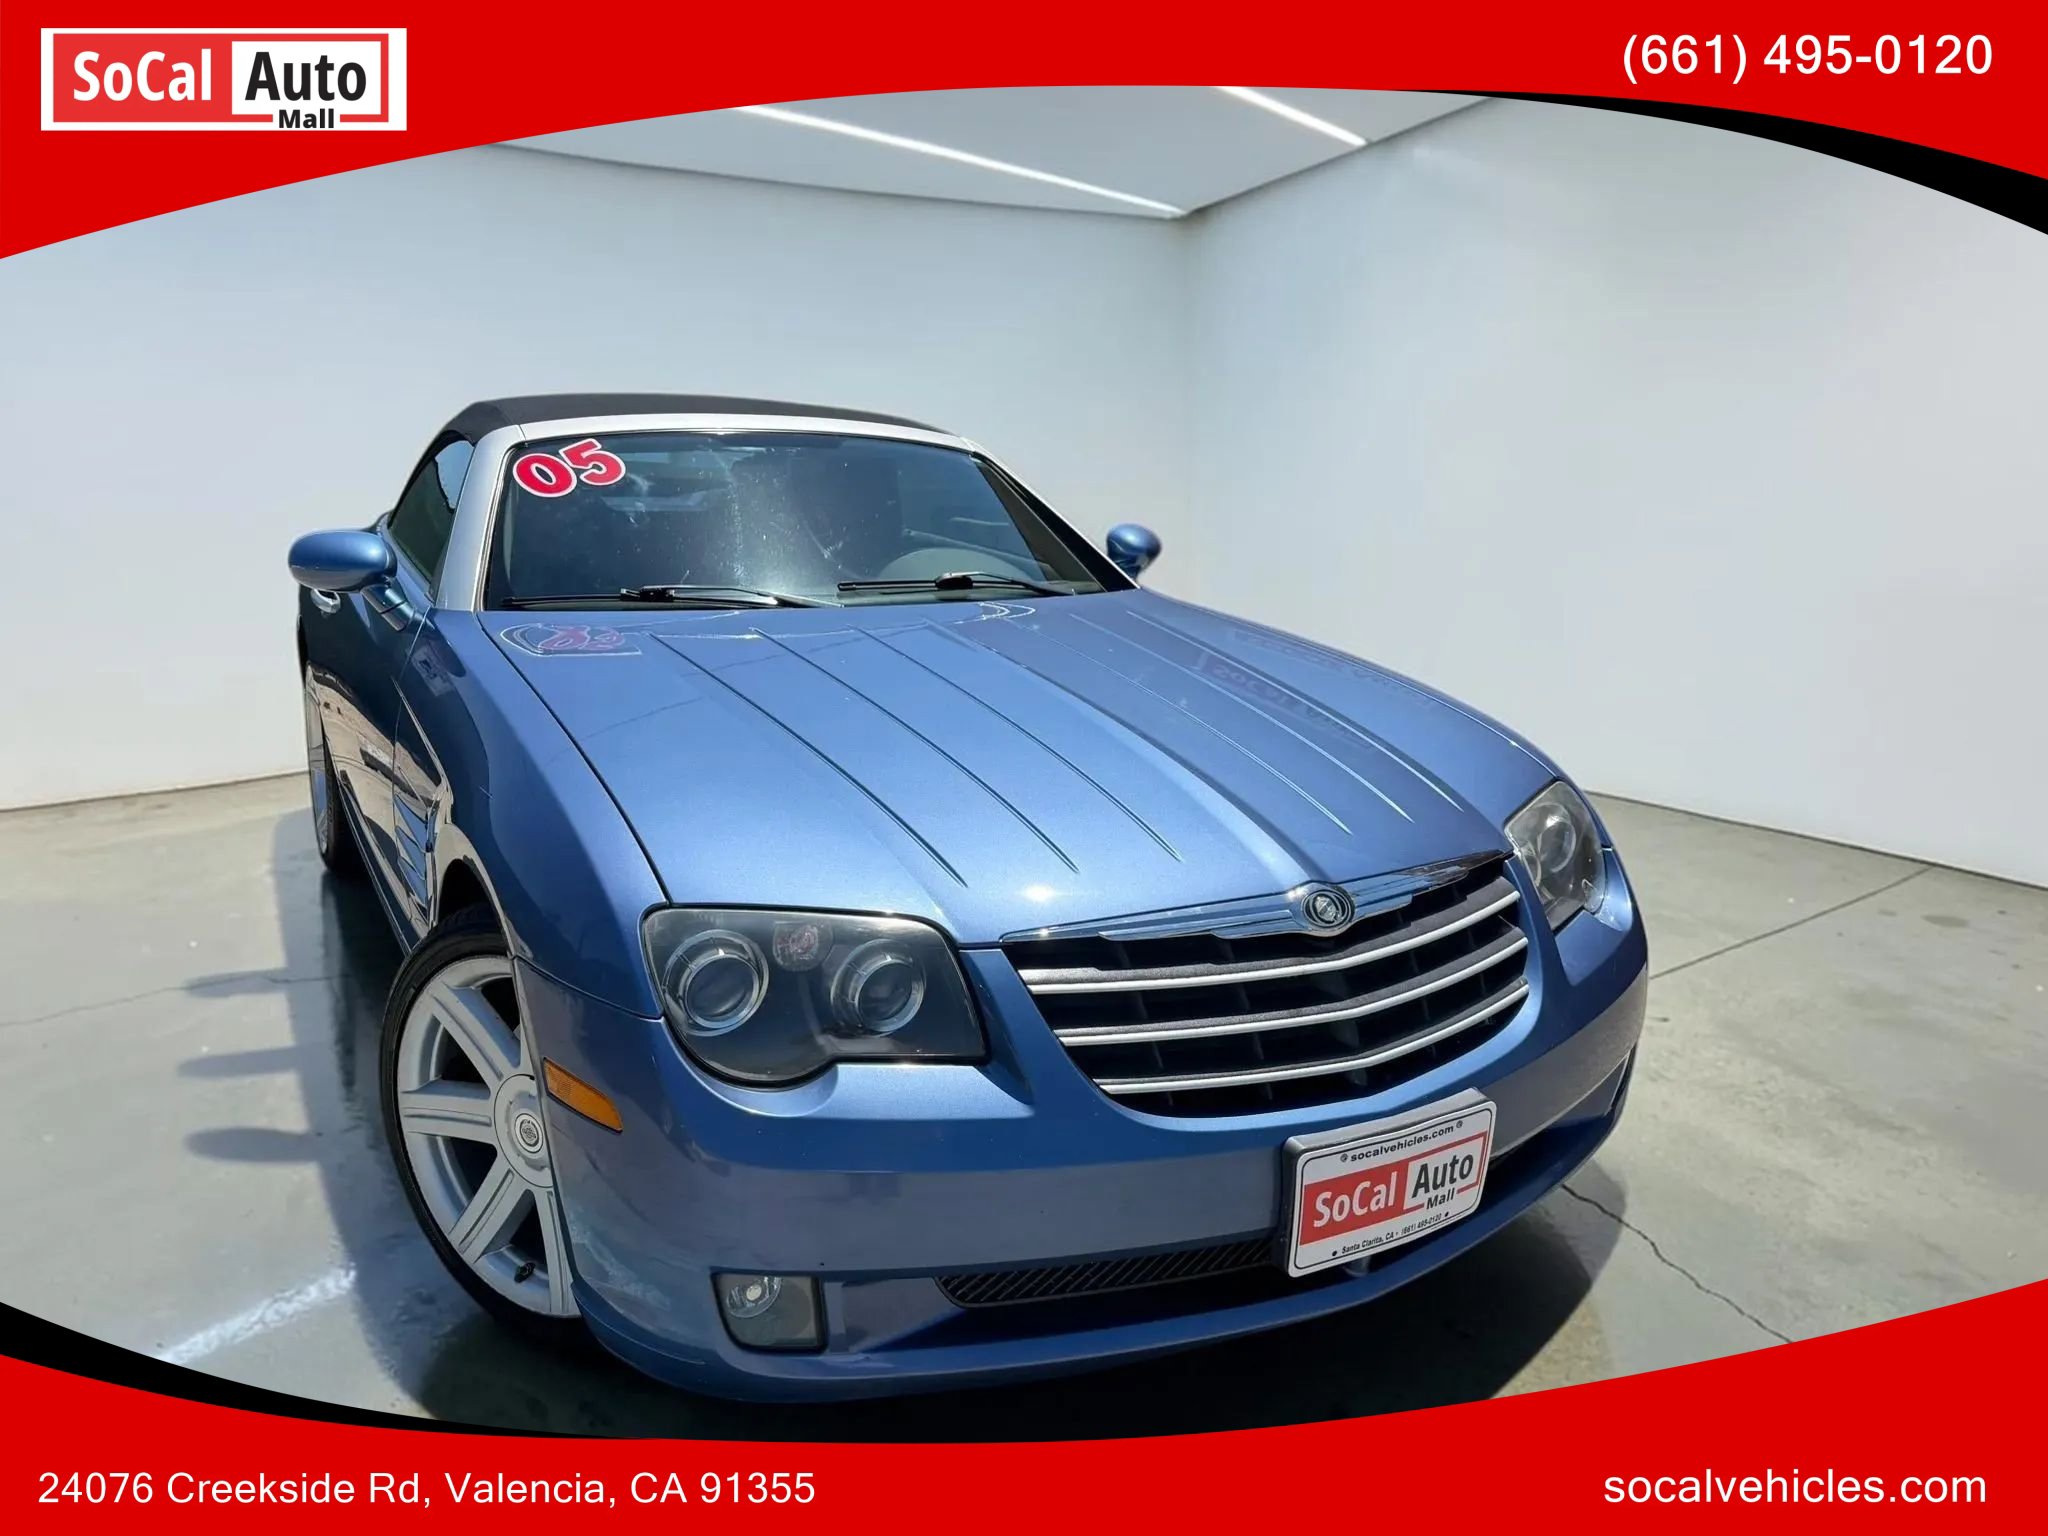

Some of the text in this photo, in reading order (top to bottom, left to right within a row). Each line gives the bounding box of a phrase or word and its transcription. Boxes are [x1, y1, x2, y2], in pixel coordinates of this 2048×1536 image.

[513, 438, 626, 498] 05
[1350, 1125, 1454, 1162] socalvehicles.com
[1313, 1153, 1474, 1228] SoCal Auto
[1426, 1188, 1455, 1210] Mall
[1341, 1243, 1360, 1254] Santa
[1385, 1232, 1395, 1241] CA
